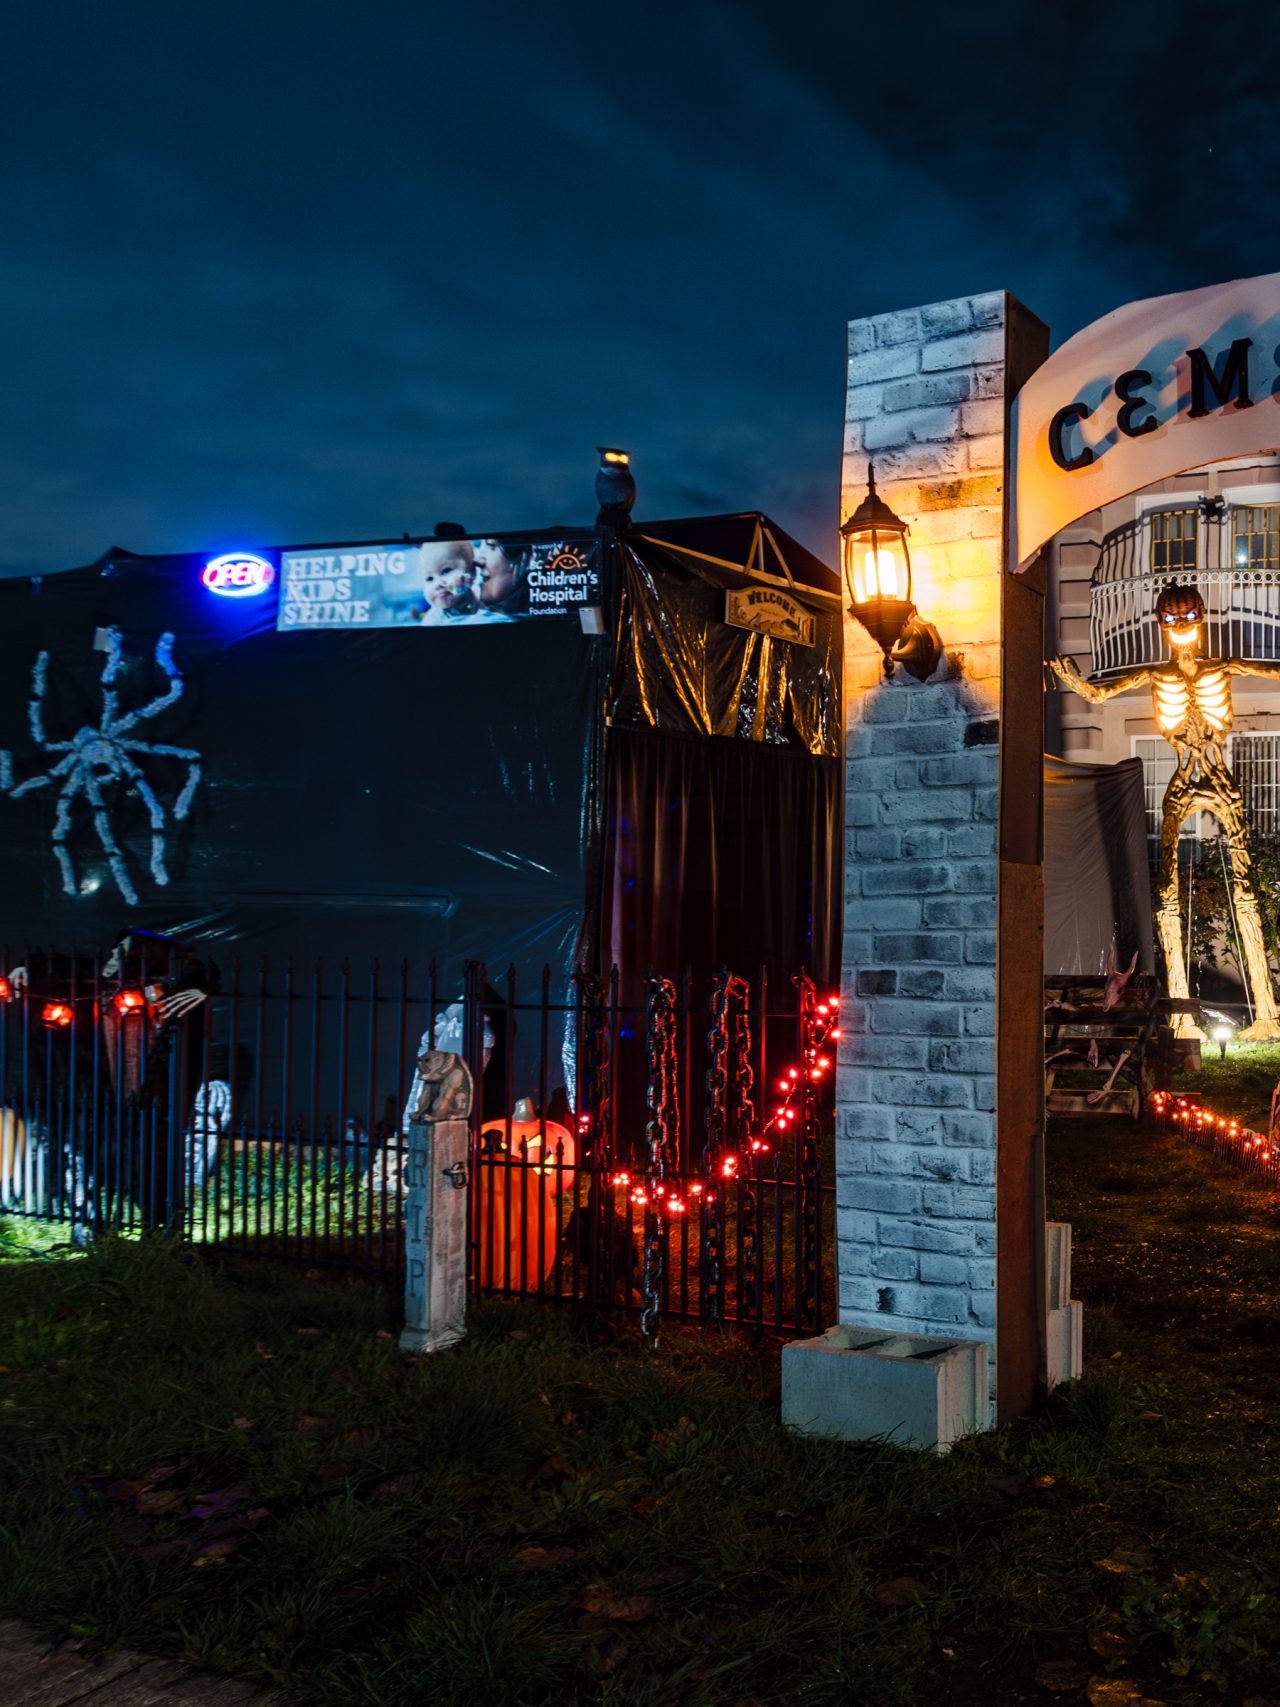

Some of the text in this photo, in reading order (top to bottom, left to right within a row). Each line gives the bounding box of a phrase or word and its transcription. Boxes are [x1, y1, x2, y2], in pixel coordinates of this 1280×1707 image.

[202, 562, 272, 588] OPEN
[287, 552, 405, 580] HELPING
[529, 560, 543, 570] BC
[527, 570, 598, 586] Children's
[285, 578, 352, 602] KIDS
[529, 586, 587, 605] Hospital
[284, 601, 370, 624] SHINE
[529, 606, 567, 615] Foundation
[747, 591, 797, 616] WELCOME
